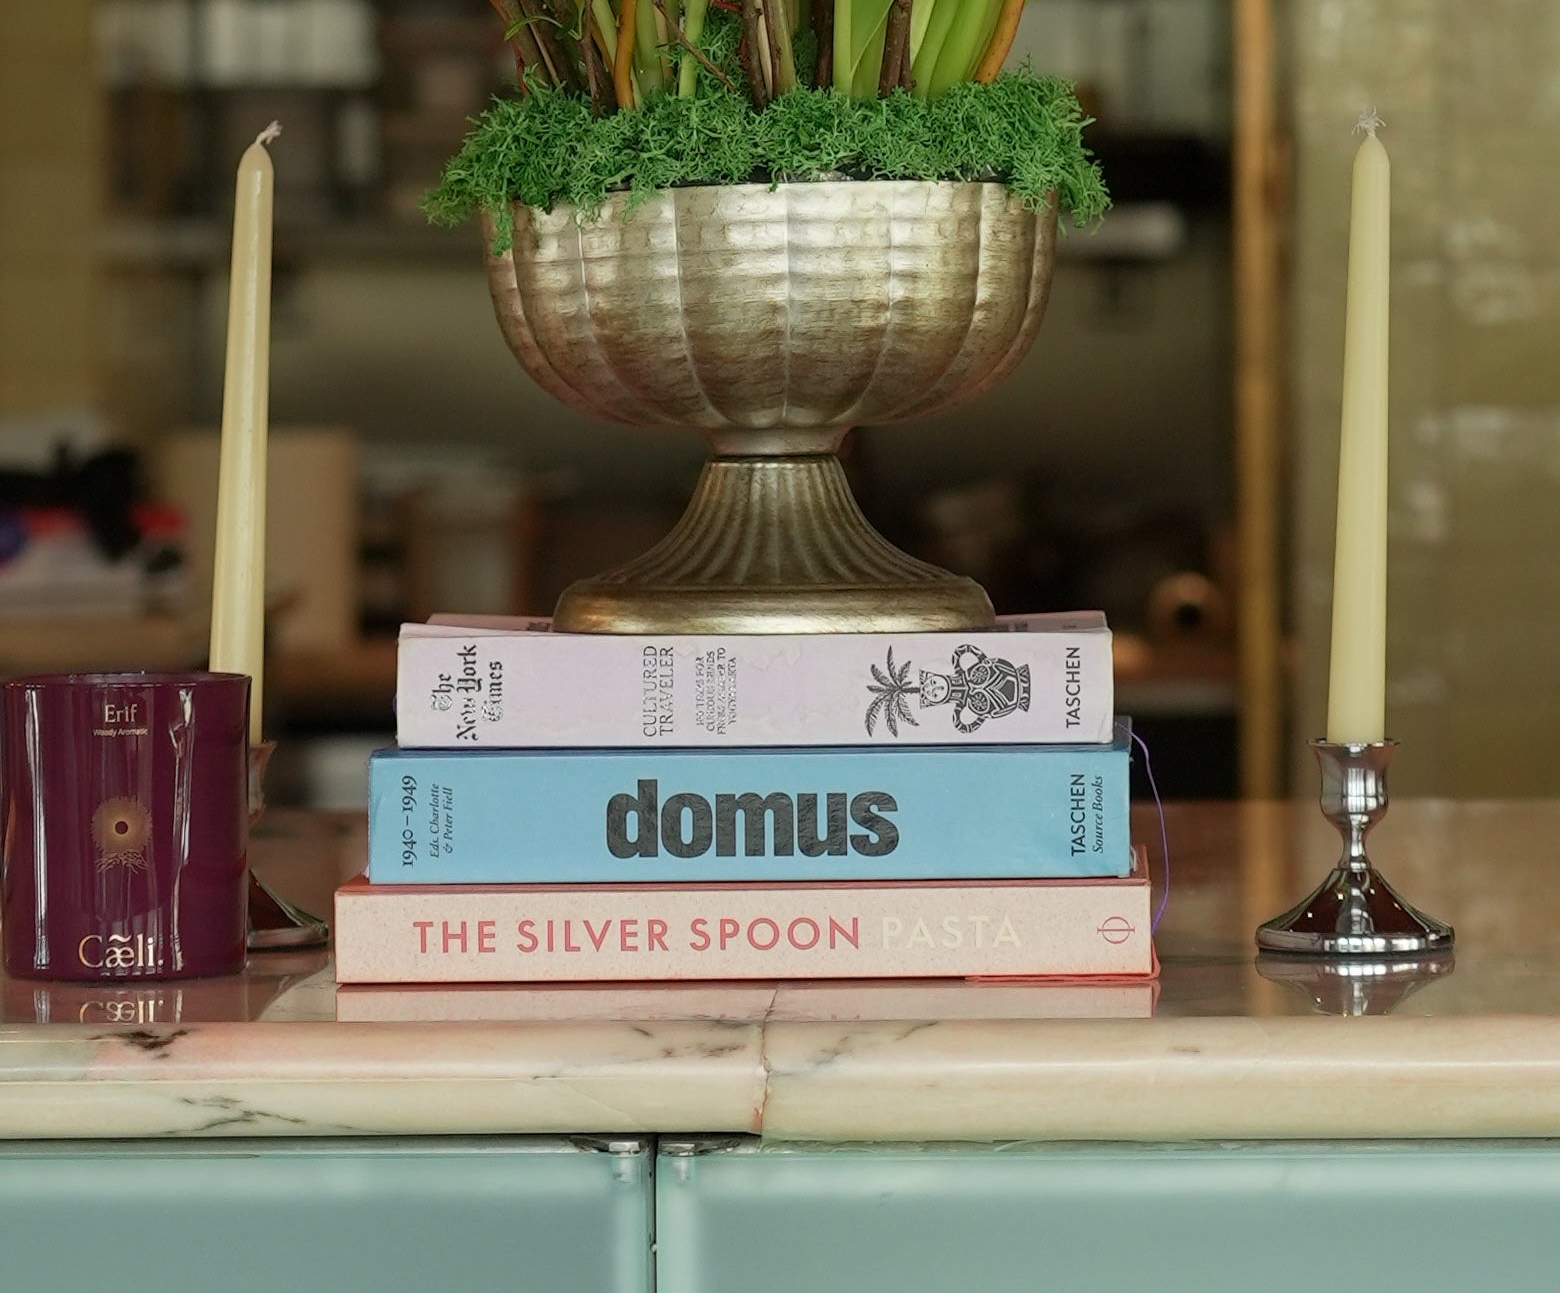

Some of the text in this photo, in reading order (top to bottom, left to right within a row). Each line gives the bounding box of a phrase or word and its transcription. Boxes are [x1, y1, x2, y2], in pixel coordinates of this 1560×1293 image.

[717, 647, 726, 661] TO
[1065, 647, 1080, 729] TASCHEN
[104, 704, 138, 723] Erif
[430, 673, 455, 712] The
[455, 644, 482, 741] New York
[480, 661, 504, 722] Times
[642, 645, 657, 738] CULTURED
[659, 646, 674, 737] TRAVELER
[428, 783, 440, 834] Charlotte
[442, 787, 453, 855] & Peter Fiell
[606, 778, 900, 859] domus
[1070, 774, 1086, 857] TASCHEN
[1091, 775, 1104, 854] Source Books
[413, 914, 1022, 953] THE SILVER SPOON PASTA
